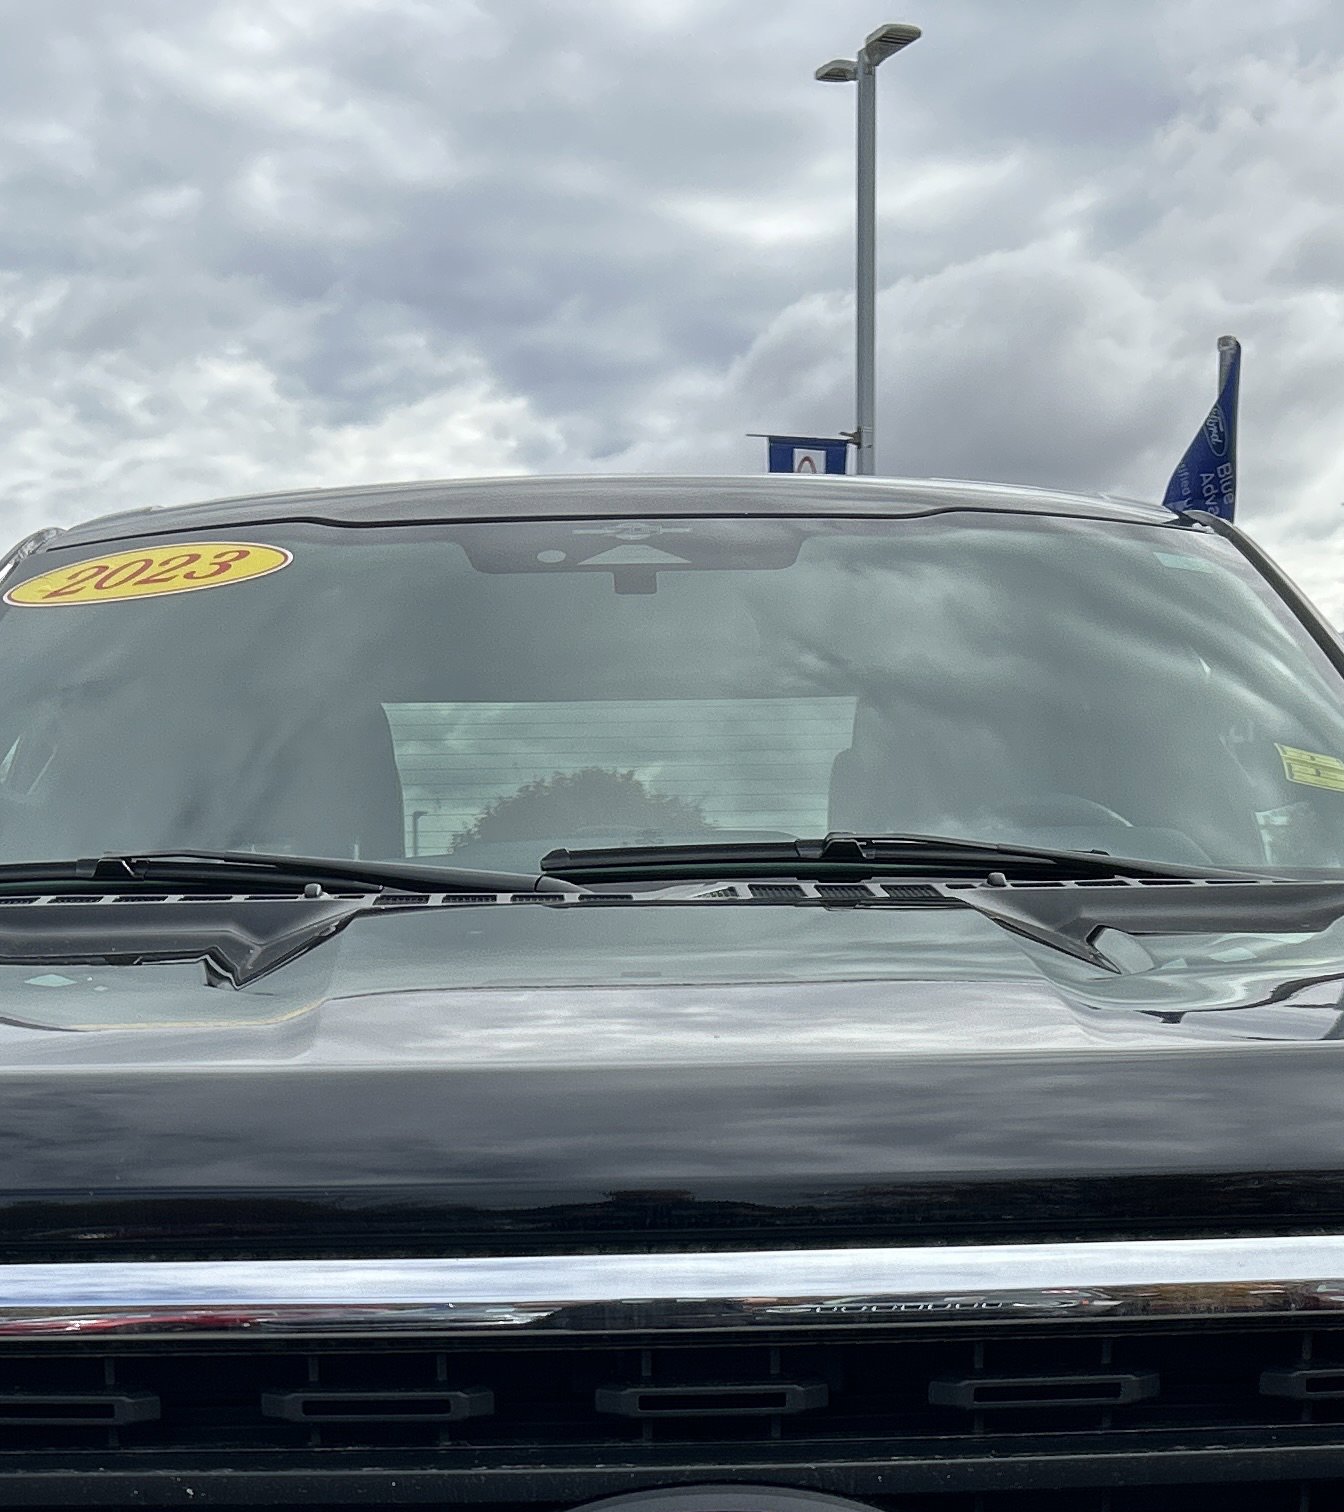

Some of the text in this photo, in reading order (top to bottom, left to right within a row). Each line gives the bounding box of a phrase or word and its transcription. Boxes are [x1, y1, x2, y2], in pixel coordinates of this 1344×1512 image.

[1200, 472, 1221, 516] Adva
[1216, 461, 1234, 505] Blue
[42, 549, 251, 600] 2023
